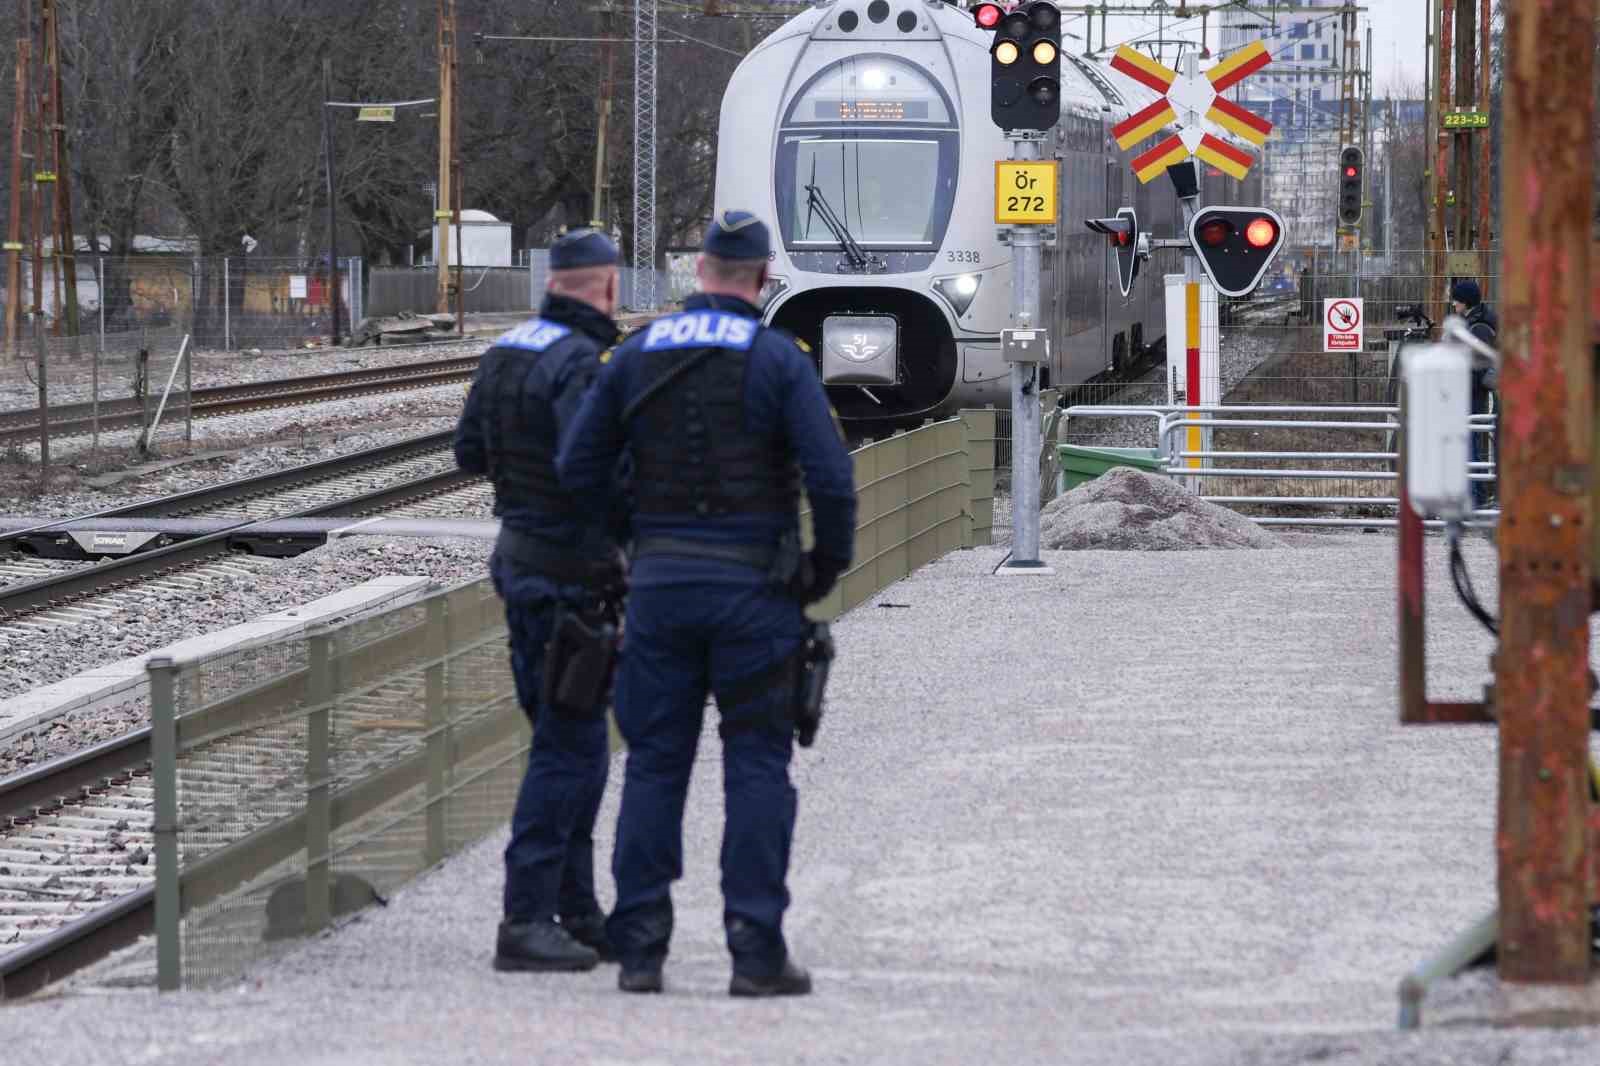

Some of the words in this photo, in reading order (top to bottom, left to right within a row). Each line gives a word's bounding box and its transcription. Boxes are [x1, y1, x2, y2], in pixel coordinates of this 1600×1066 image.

[1445, 114, 1487, 125] 223-3a
[1015, 170, 1038, 190] Ör
[1007, 196, 1044, 212] 272
[947, 250, 980, 264] 3338
[645, 313, 751, 347] POLIS
